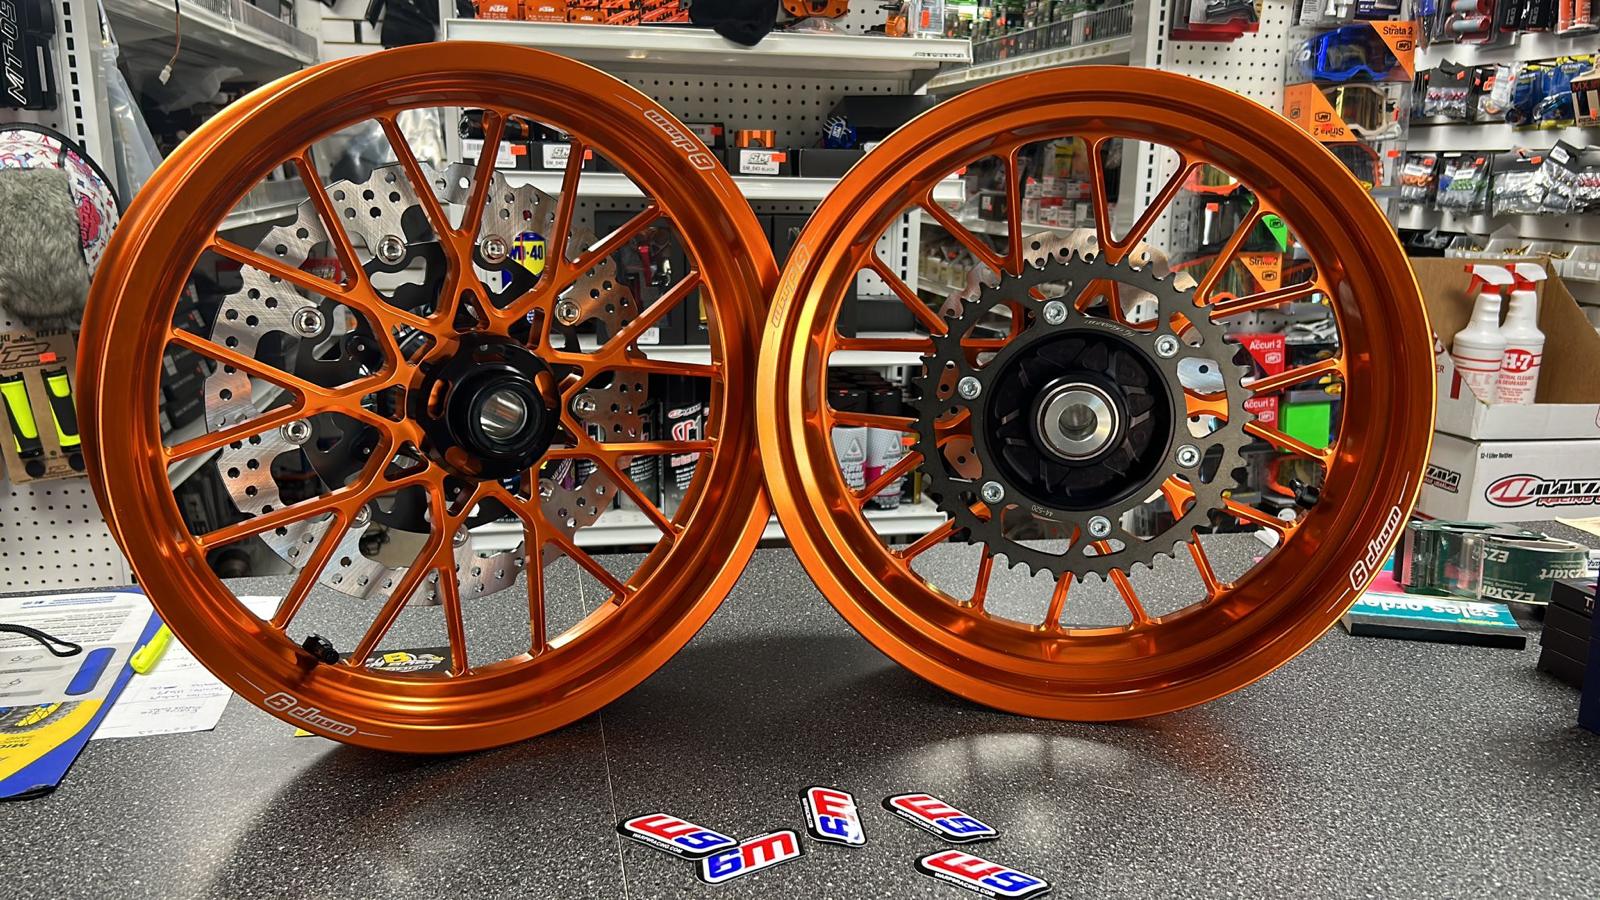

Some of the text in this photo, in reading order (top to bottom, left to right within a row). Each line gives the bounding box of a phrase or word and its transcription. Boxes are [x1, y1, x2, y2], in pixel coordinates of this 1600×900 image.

[1382, 26, 1413, 36] Strata 2
[1313, 127, 1319, 136] 2
[688, 152, 716, 170] 9
[1249, 340, 1282, 350] Accuri 2
[1243, 398, 1275, 409] Accuri 2
[1349, 506, 1402, 591] warp 9
[1432, 601, 1499, 618] sales
[263, 691, 357, 737] warp 9
